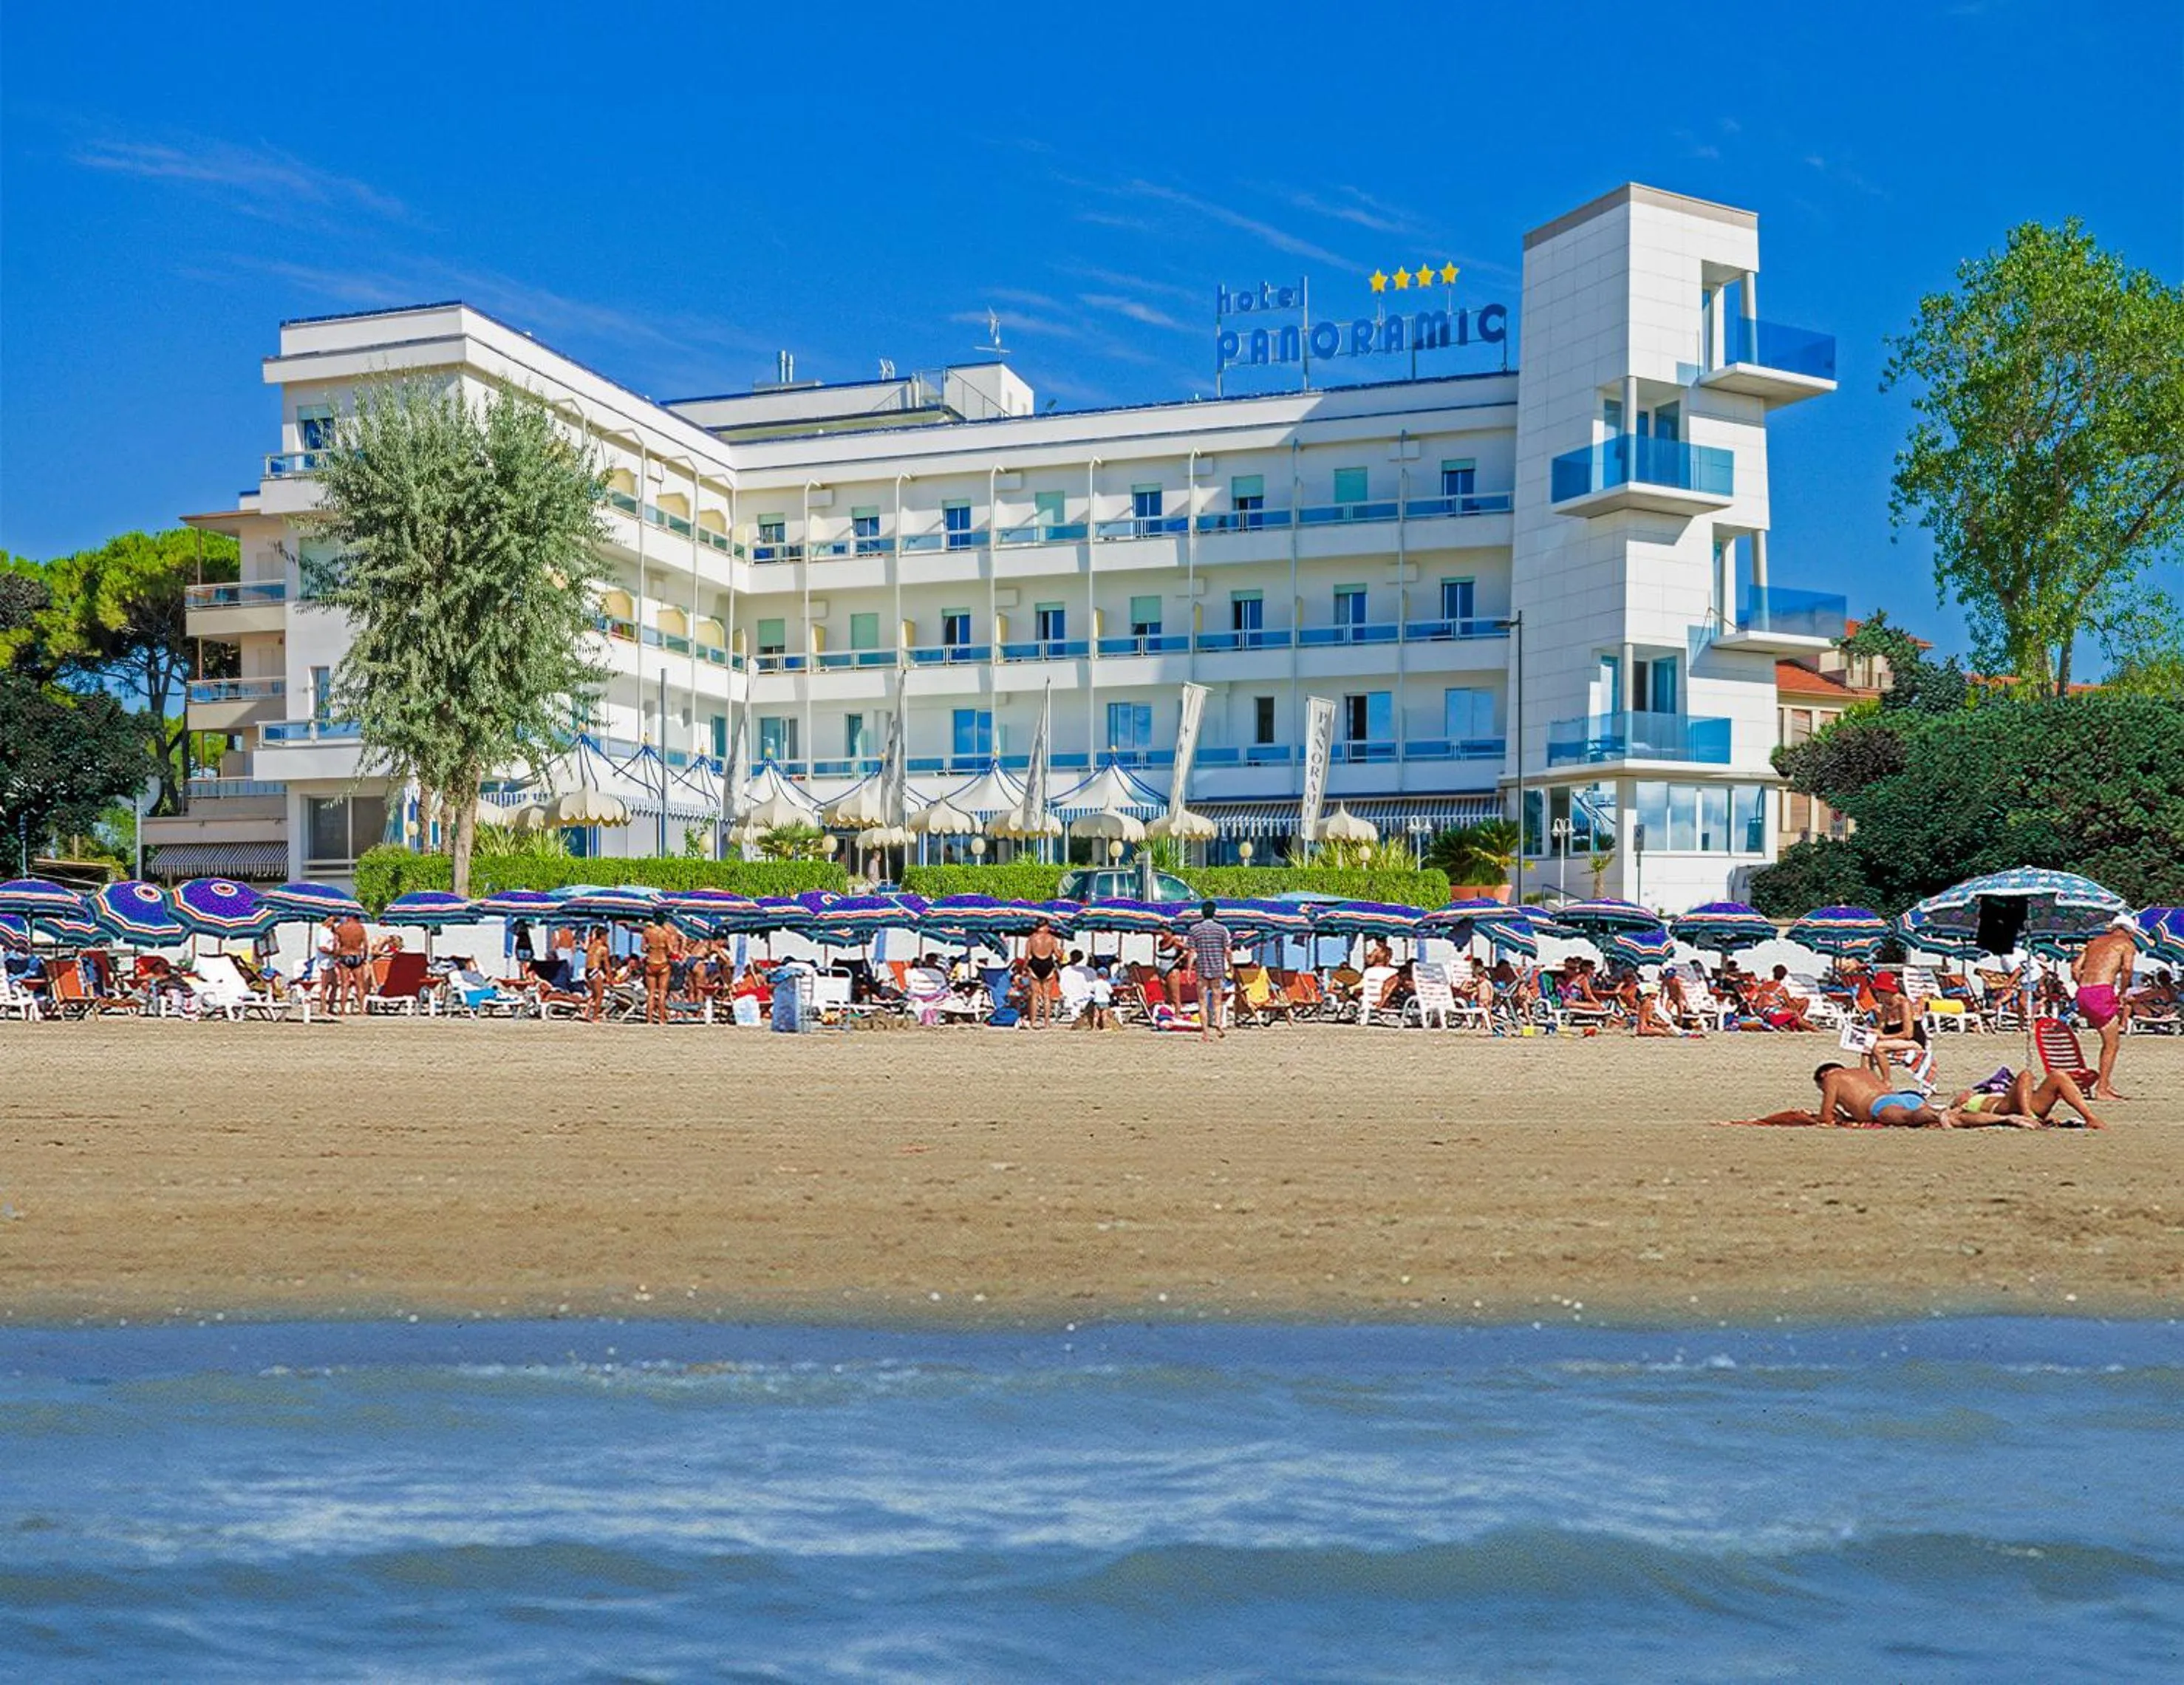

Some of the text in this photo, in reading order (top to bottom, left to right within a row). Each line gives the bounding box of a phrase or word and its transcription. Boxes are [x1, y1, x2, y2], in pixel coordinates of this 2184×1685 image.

[1217, 276, 1305, 314] hotel
[1217, 303, 1507, 369] PANORAMIC
[1306, 711, 1327, 823] PANORAMI
